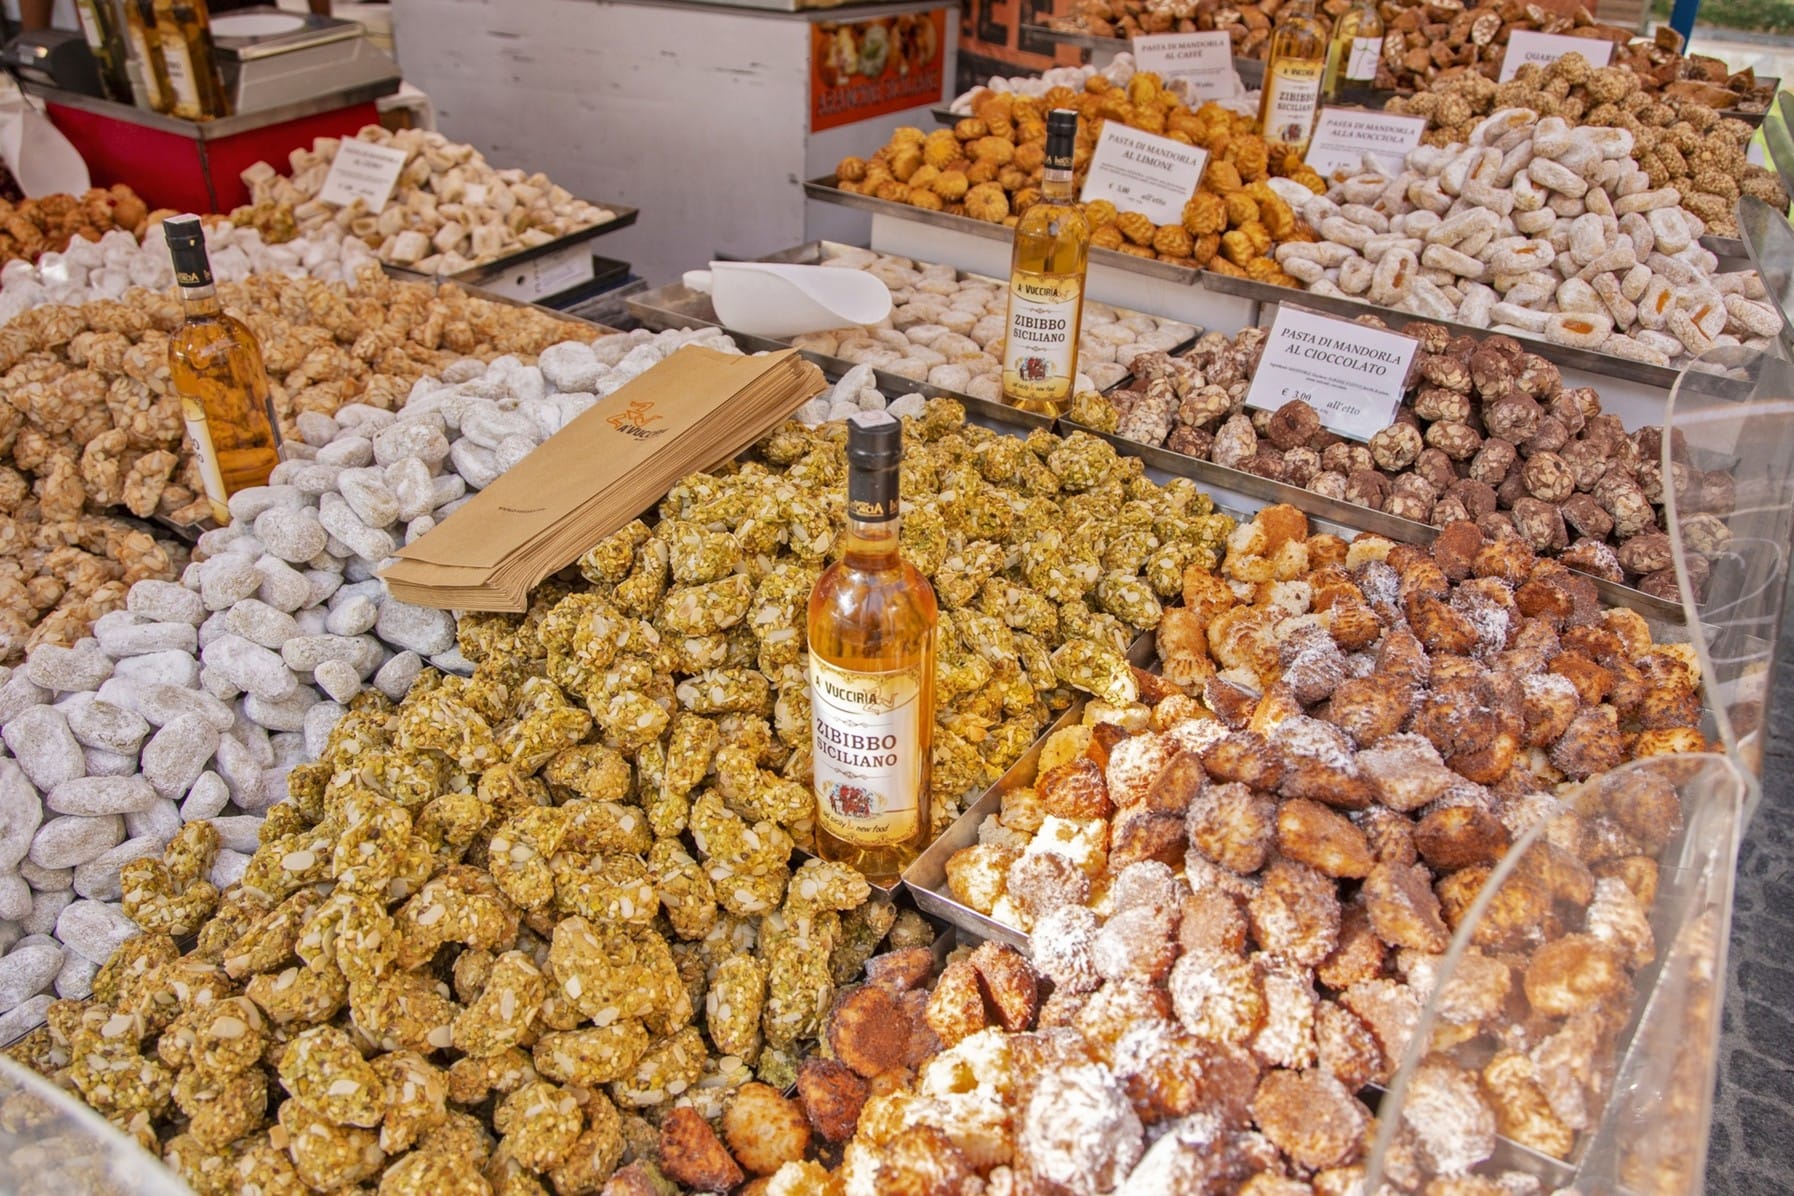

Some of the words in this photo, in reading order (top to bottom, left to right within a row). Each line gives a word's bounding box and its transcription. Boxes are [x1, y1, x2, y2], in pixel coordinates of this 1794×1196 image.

[1178, 40, 1225, 49] MANDORLA
[1327, 120, 1352, 129] PASTA
[1354, 122, 1364, 130] DI
[1365, 123, 1415, 135] MANDORLA
[1331, 129, 1354, 138] ALLA
[1356, 131, 1404, 144] NOCCIOLA
[1108, 133, 1135, 147] PASTA
[1135, 141, 1145, 150] DI
[1146, 143, 1198, 166] MANDORLA
[1122, 150, 1135, 160] AL
[1136, 153, 1174, 172] LIMONE
[1025, 285, 1059, 297] VUCCIRIA
[1014, 314, 1066, 330] ZIBIBBO
[1013, 327, 1066, 343] SICILIANO
[1281, 327, 1316, 345] PASTA
[1318, 336, 1331, 349] DI
[1332, 340, 1401, 365] MANDORLA
[1285, 343, 1301, 356] AL
[1303, 347, 1387, 376] CIOCCOLATO
[1281, 387, 1290, 396] €
[1292, 390, 1312, 402] 3,00
[1326, 400, 1361, 416] all'etto
[825, 682, 877, 705] VUCCIRIA
[816, 717, 897, 751] ZIBIBBO
[816, 735, 898, 768] SICILIANO
[872, 823, 890, 833] food
